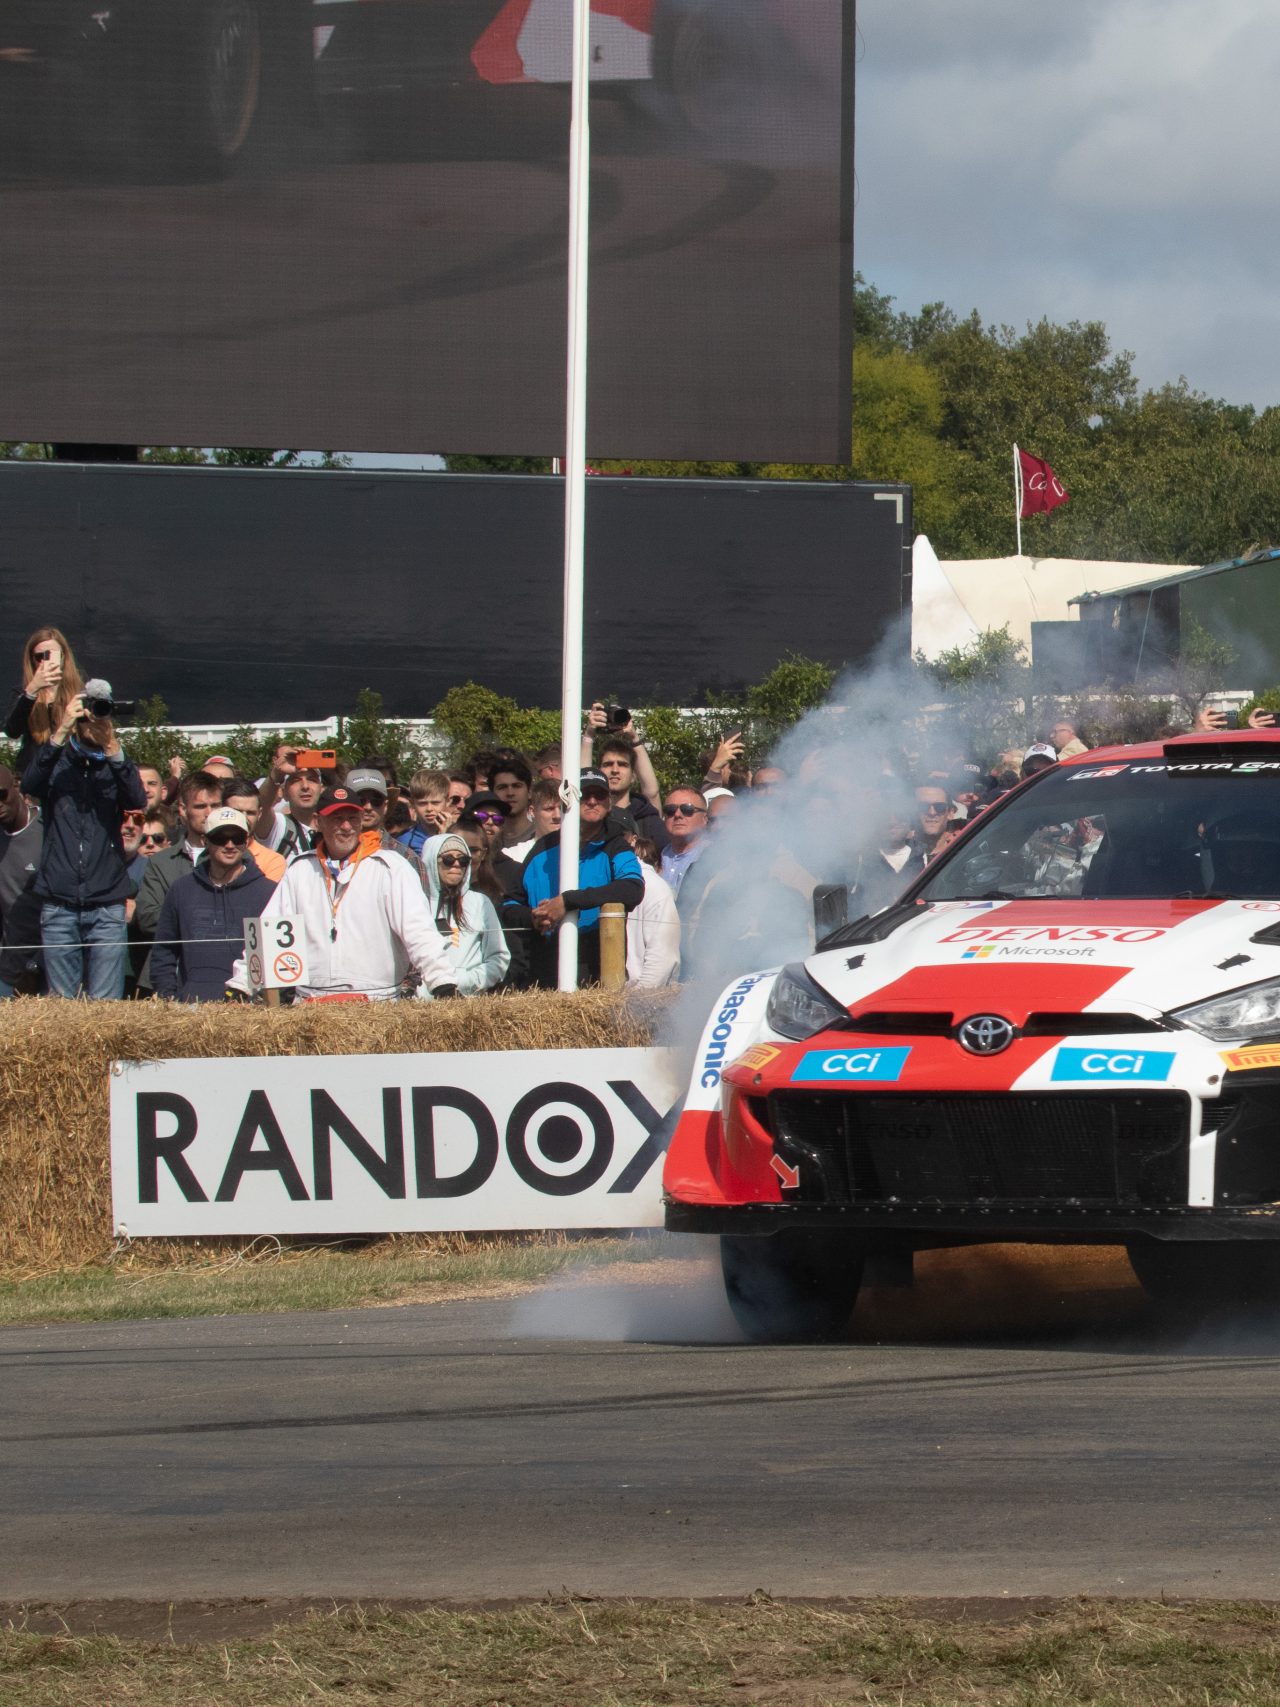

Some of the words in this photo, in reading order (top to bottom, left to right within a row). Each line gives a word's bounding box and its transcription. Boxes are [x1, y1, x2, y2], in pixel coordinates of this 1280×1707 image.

[1130, 763, 1234, 774] TOYOTA
[248, 922, 257, 950] 3
[276, 920, 295, 948] 3
[936, 927, 1167, 944] DENSO
[997, 945, 1097, 958] Microsoft
[822, 1053, 882, 1073] CCi
[1080, 1052, 1145, 1074] CCi
[136, 1079, 684, 1204] RANDOX
